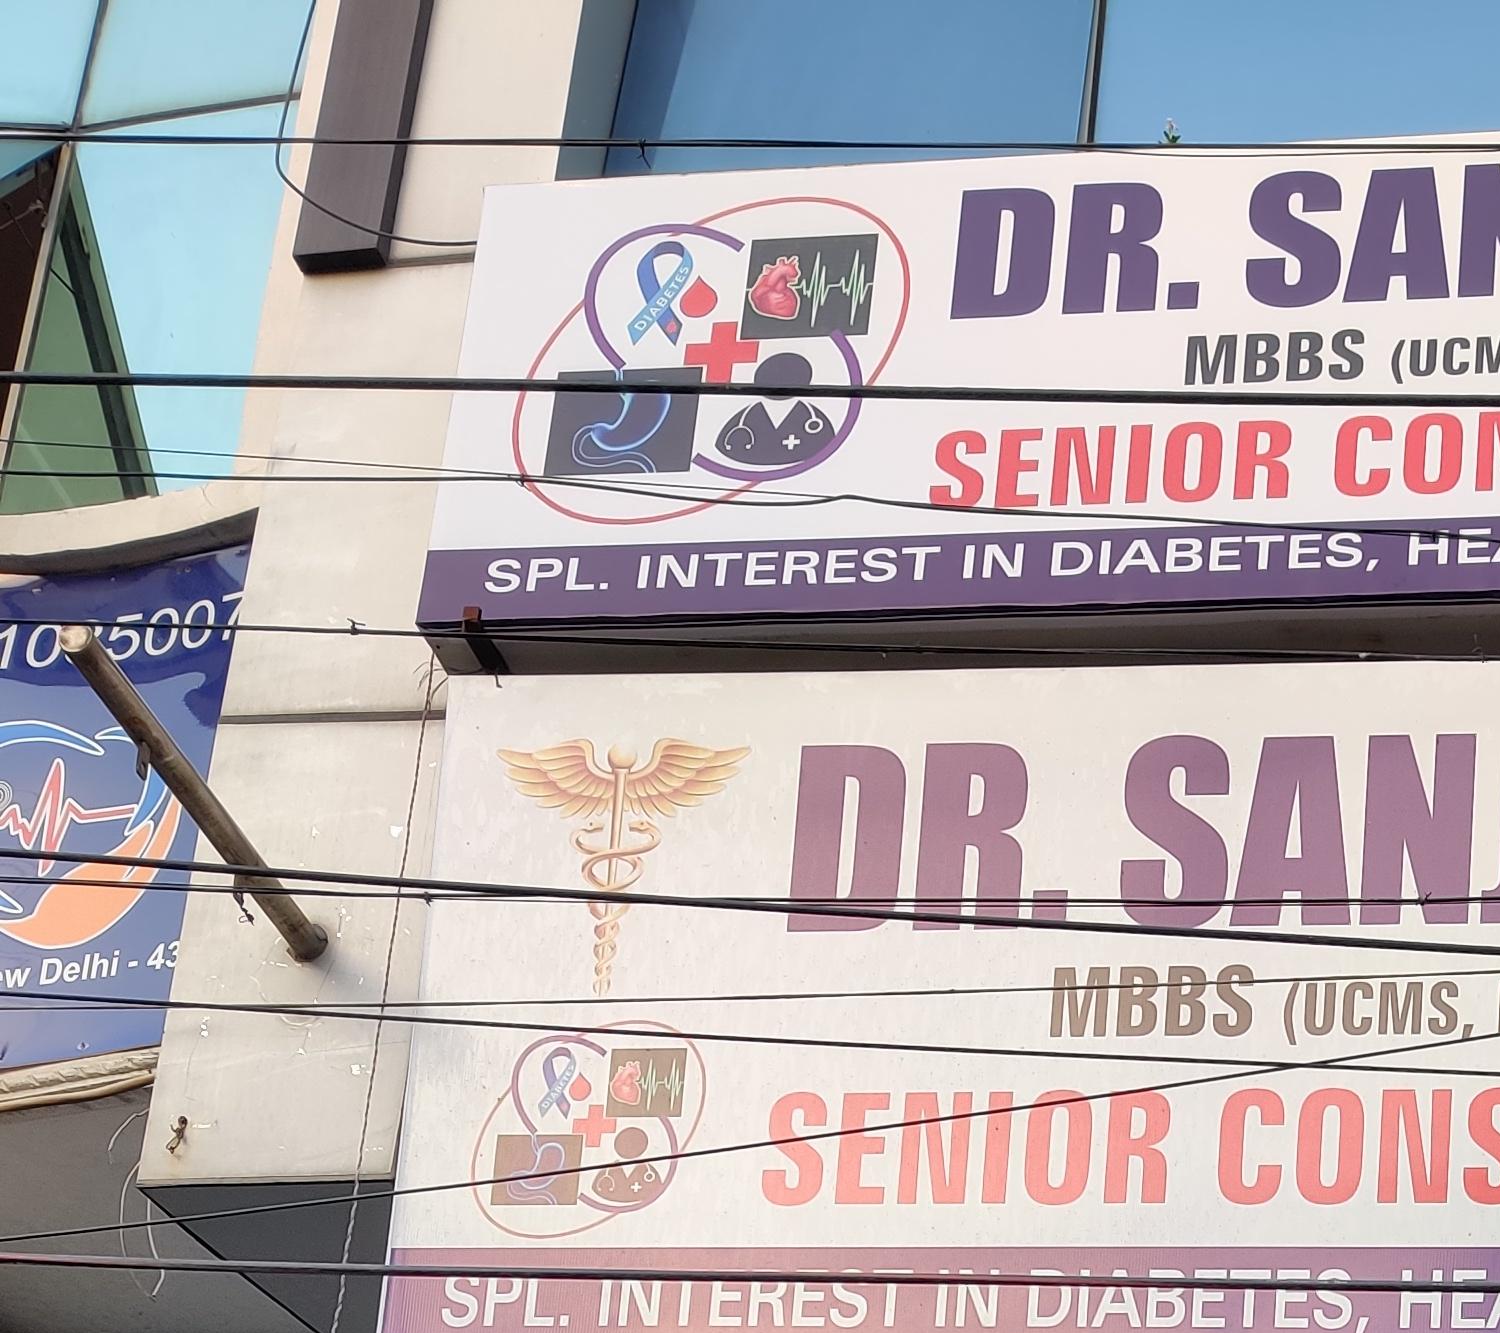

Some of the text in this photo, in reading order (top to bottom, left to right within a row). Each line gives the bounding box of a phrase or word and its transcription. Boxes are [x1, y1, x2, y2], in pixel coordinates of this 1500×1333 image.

[949, 182, 1200, 320] DR.
[1184, 329, 1365, 385] MBBS
[930, 419, 1292, 508] SENIOR
[484, 554, 608, 594] SPL.
[636, 545, 939, 590] INTEREST
[961, 540, 1024, 580] IN
[1050, 529, 1380, 574] DIABETES,
[786, 743, 1068, 933] DR.
[39, 949, 120, 987] Delhi
[1049, 964, 1254, 1038] MBBS
[1282, 980, 1474, 1045] (UCMS,
[761, 1089, 1171, 1206] SENIOR
